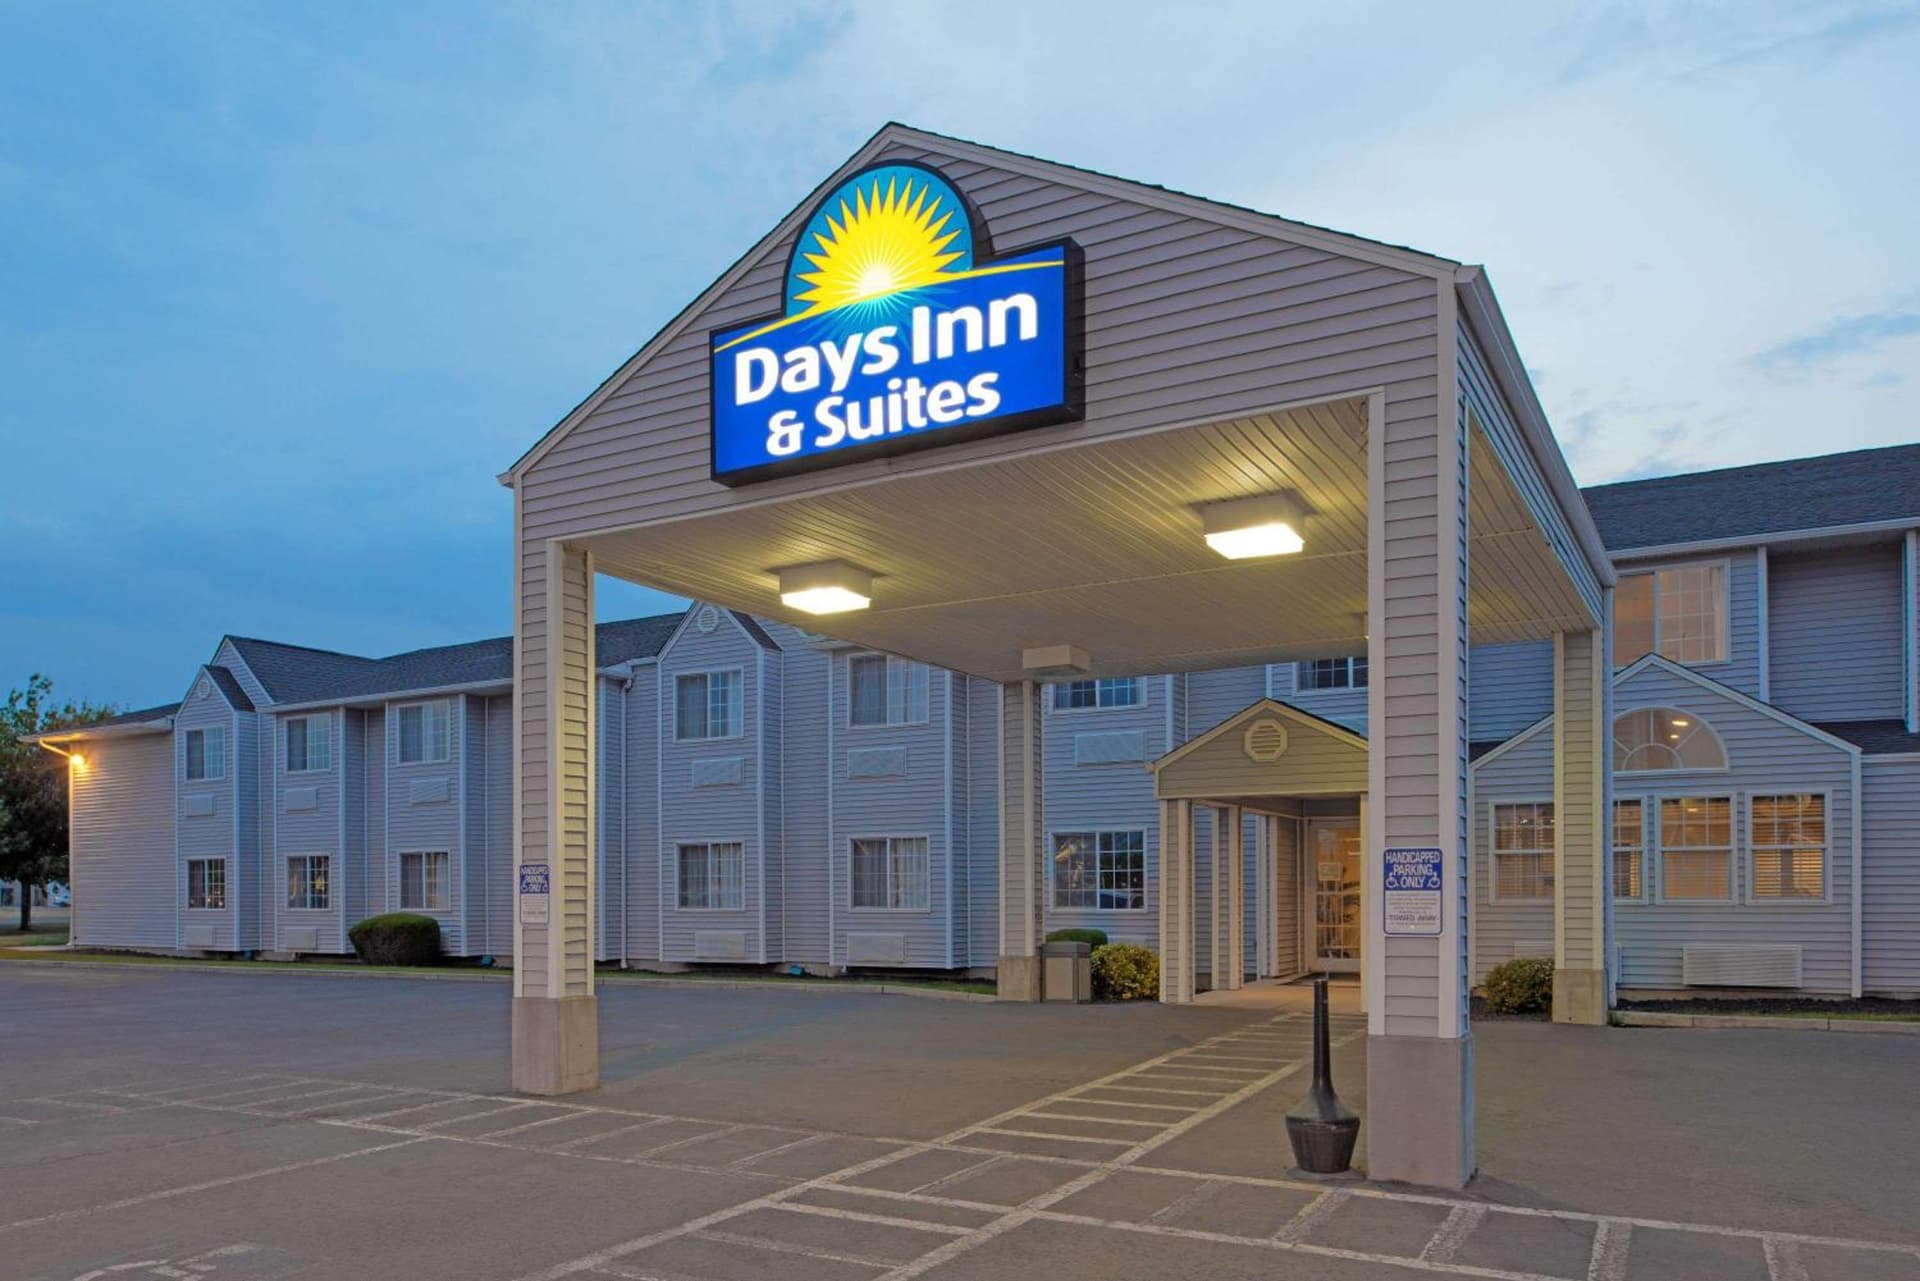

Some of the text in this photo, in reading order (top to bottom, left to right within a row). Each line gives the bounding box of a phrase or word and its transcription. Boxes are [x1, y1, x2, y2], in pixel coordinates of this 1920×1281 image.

[734, 291, 1039, 407] Days Inn
[765, 371, 1001, 457] & Suites
[1385, 851, 1441, 864] HANDICAPPED
[1393, 864, 1433, 876] PARKING
[1400, 876, 1425, 888] ONLY
